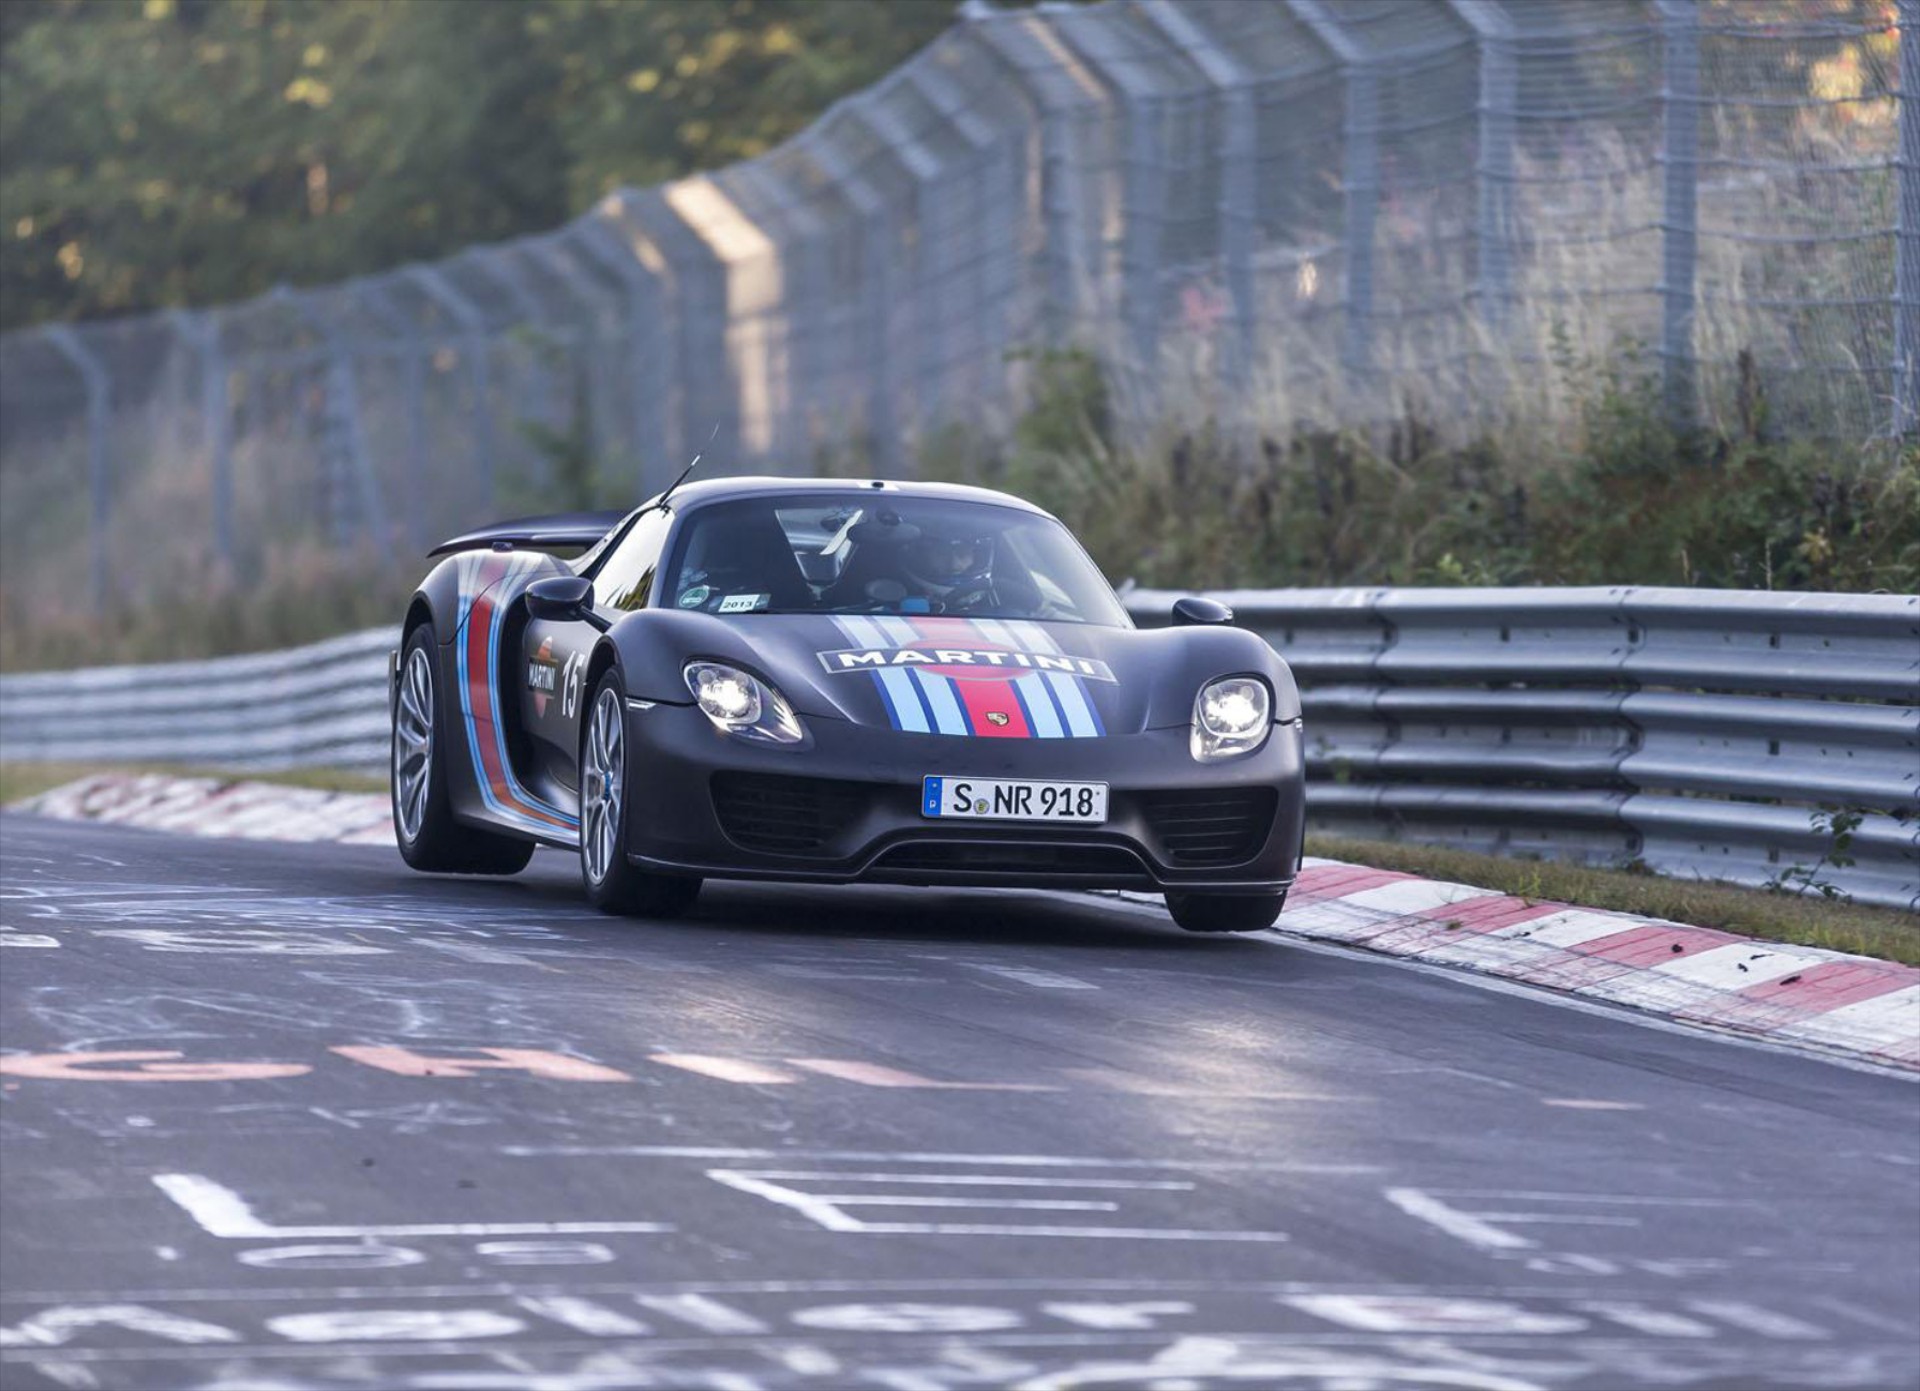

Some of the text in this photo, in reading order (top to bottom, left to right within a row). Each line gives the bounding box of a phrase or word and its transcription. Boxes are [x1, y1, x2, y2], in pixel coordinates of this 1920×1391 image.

[723, 601, 752, 609] 2013
[837, 650, 1096, 675] MARTINI
[562, 650, 586, 719] 15
[953, 783, 1094, 817] S NR 918
